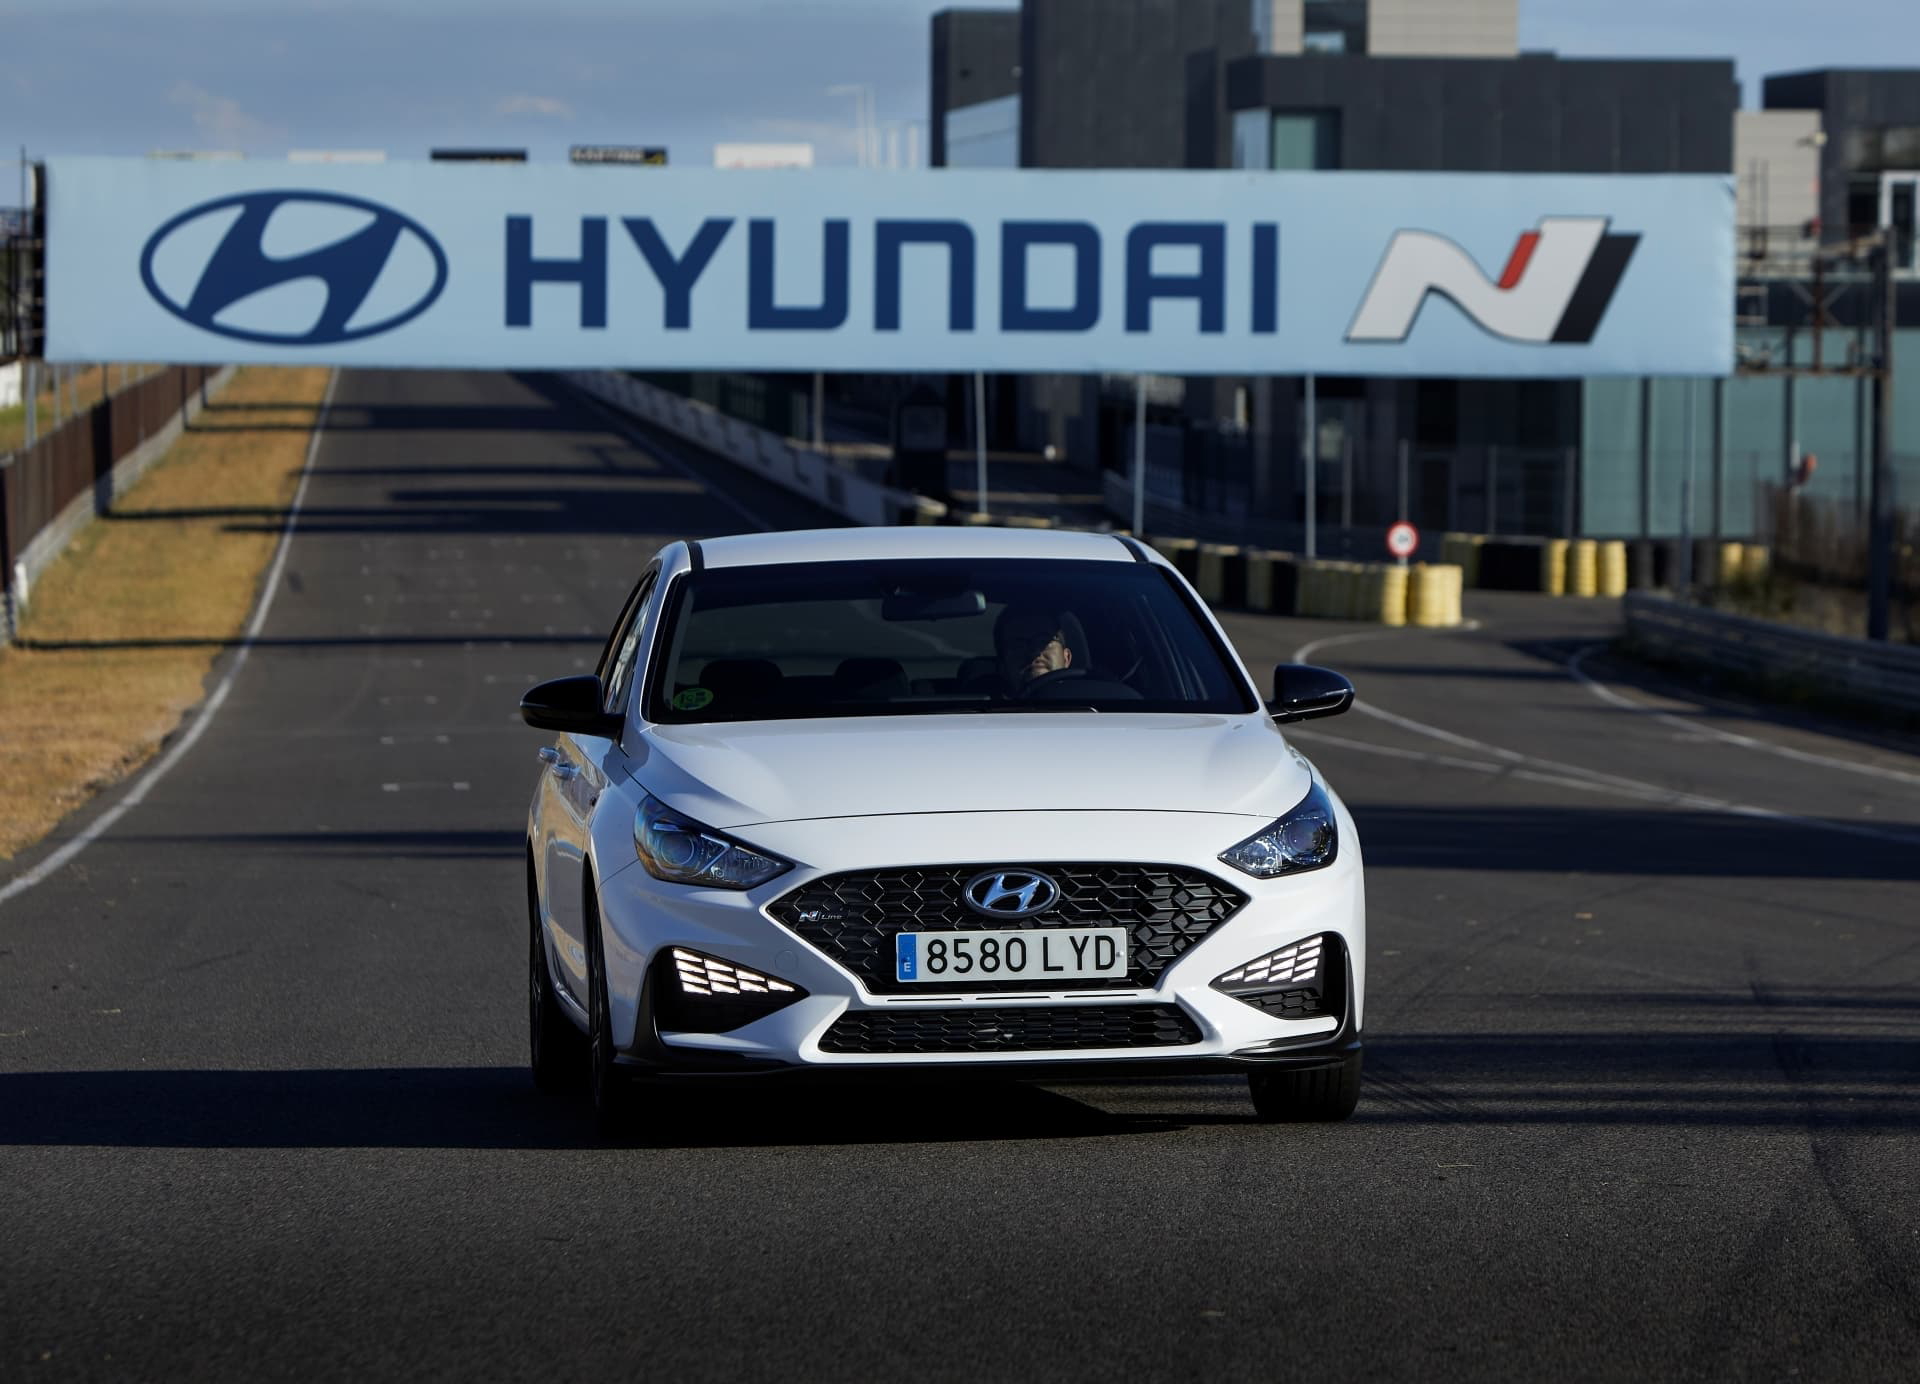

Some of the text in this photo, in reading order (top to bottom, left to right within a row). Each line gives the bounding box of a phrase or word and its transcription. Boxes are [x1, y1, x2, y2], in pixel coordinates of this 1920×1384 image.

[505, 214, 1279, 333] HYUNDAI
[904, 962, 911, 972] E
[927, 935, 1116, 974] 8580 LYD
